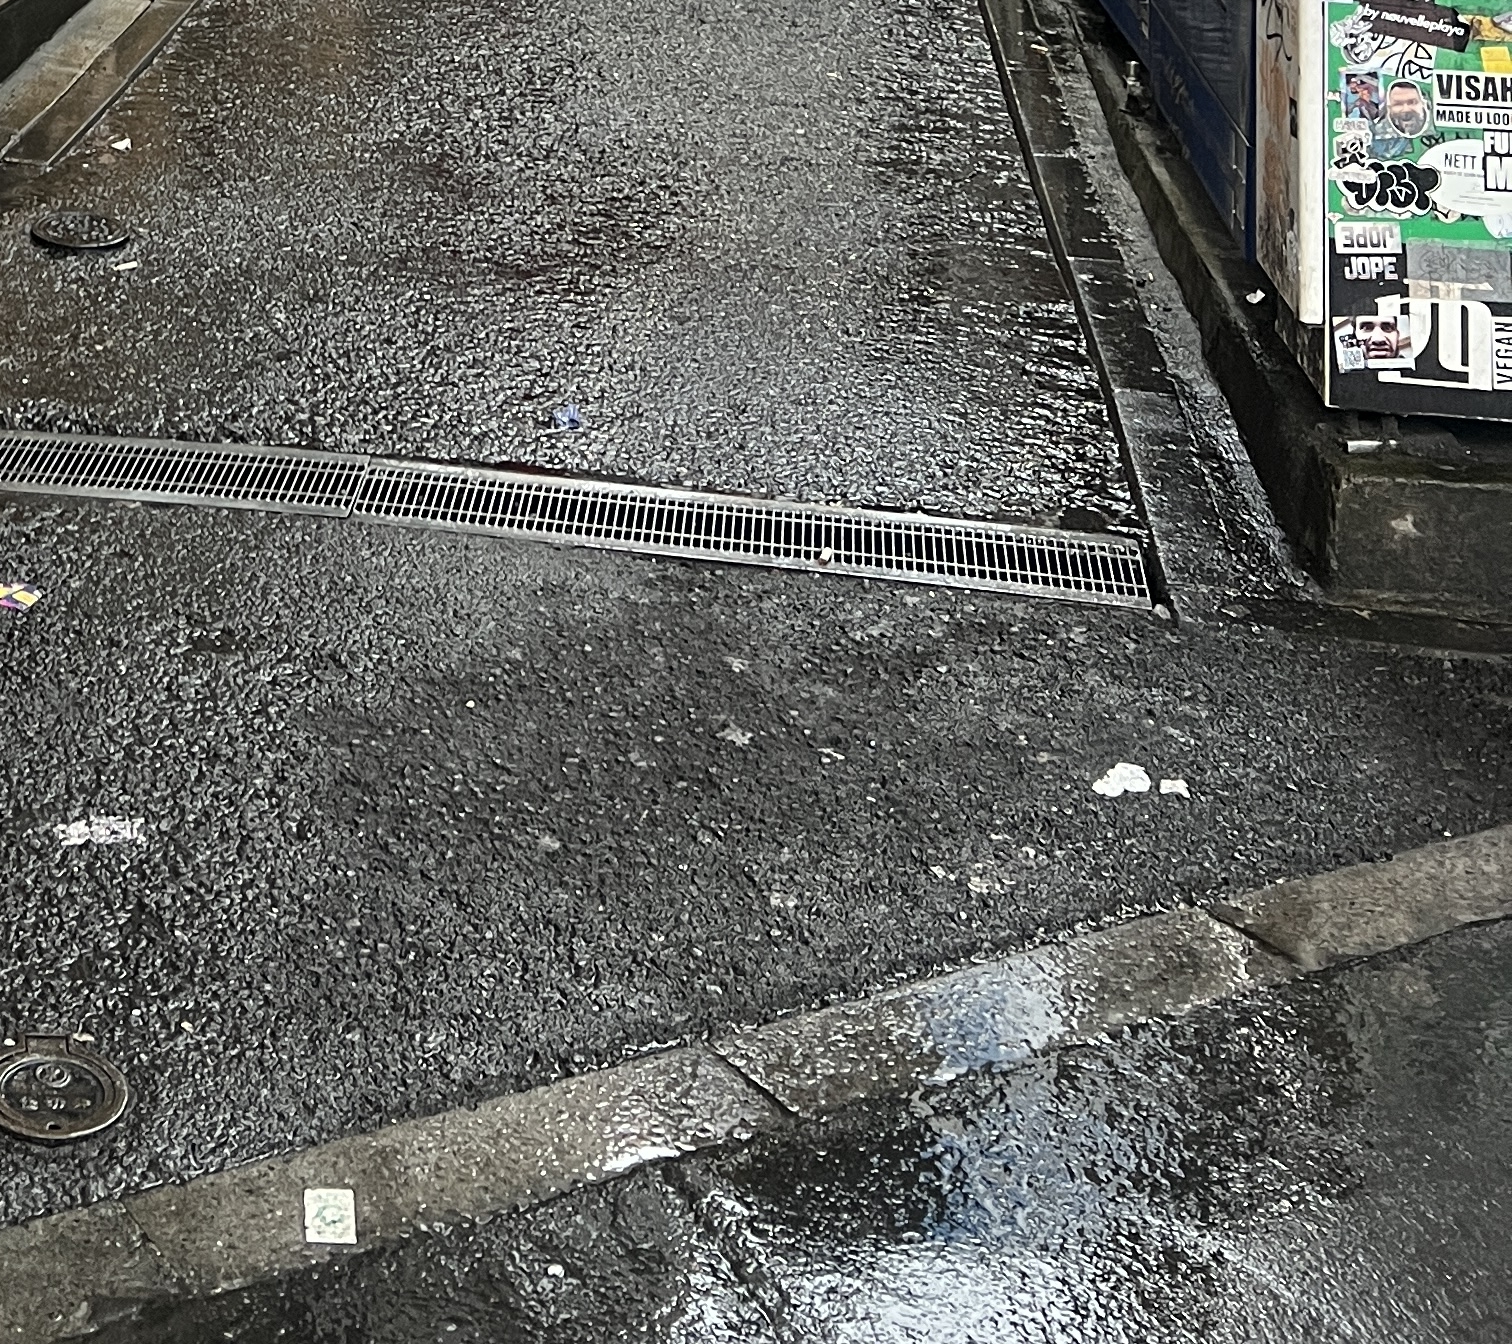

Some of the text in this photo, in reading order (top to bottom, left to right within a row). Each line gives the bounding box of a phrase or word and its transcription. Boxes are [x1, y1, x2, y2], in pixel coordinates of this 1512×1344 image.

[1435, 109, 1473, 124] MADE
[1443, 153, 1478, 171] NETT
[1344, 255, 1399, 281] JOPE
